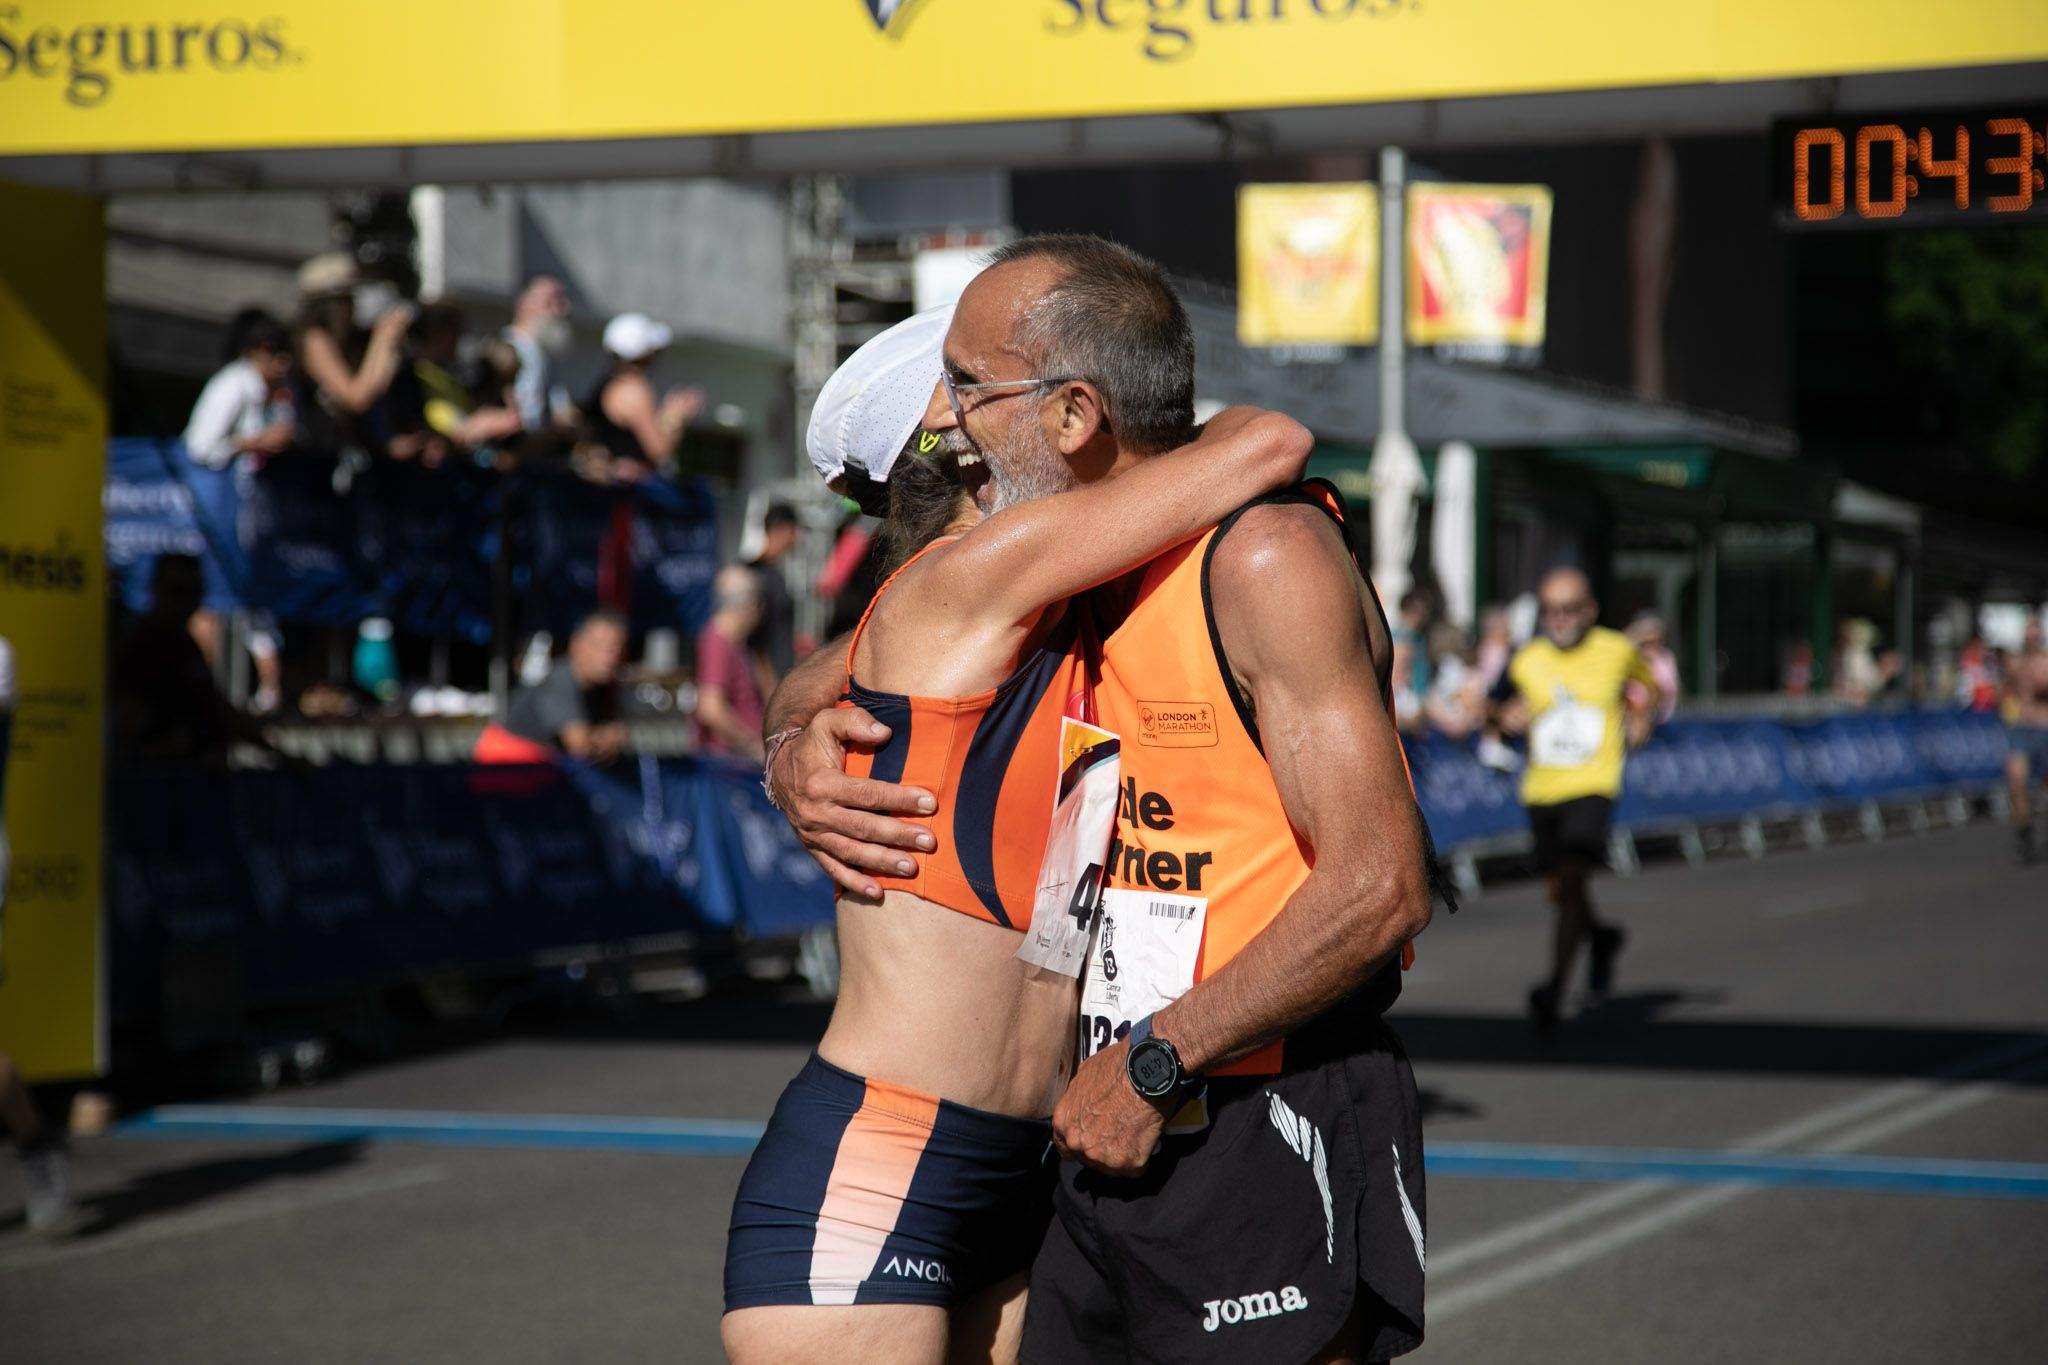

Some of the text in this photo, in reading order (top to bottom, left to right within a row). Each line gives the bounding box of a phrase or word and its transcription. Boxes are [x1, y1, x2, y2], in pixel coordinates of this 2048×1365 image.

[1157, 712, 1197, 721] LONDON
[1158, 722, 1212, 731] MARATHON
[1203, 1285, 1309, 1332] Joma
